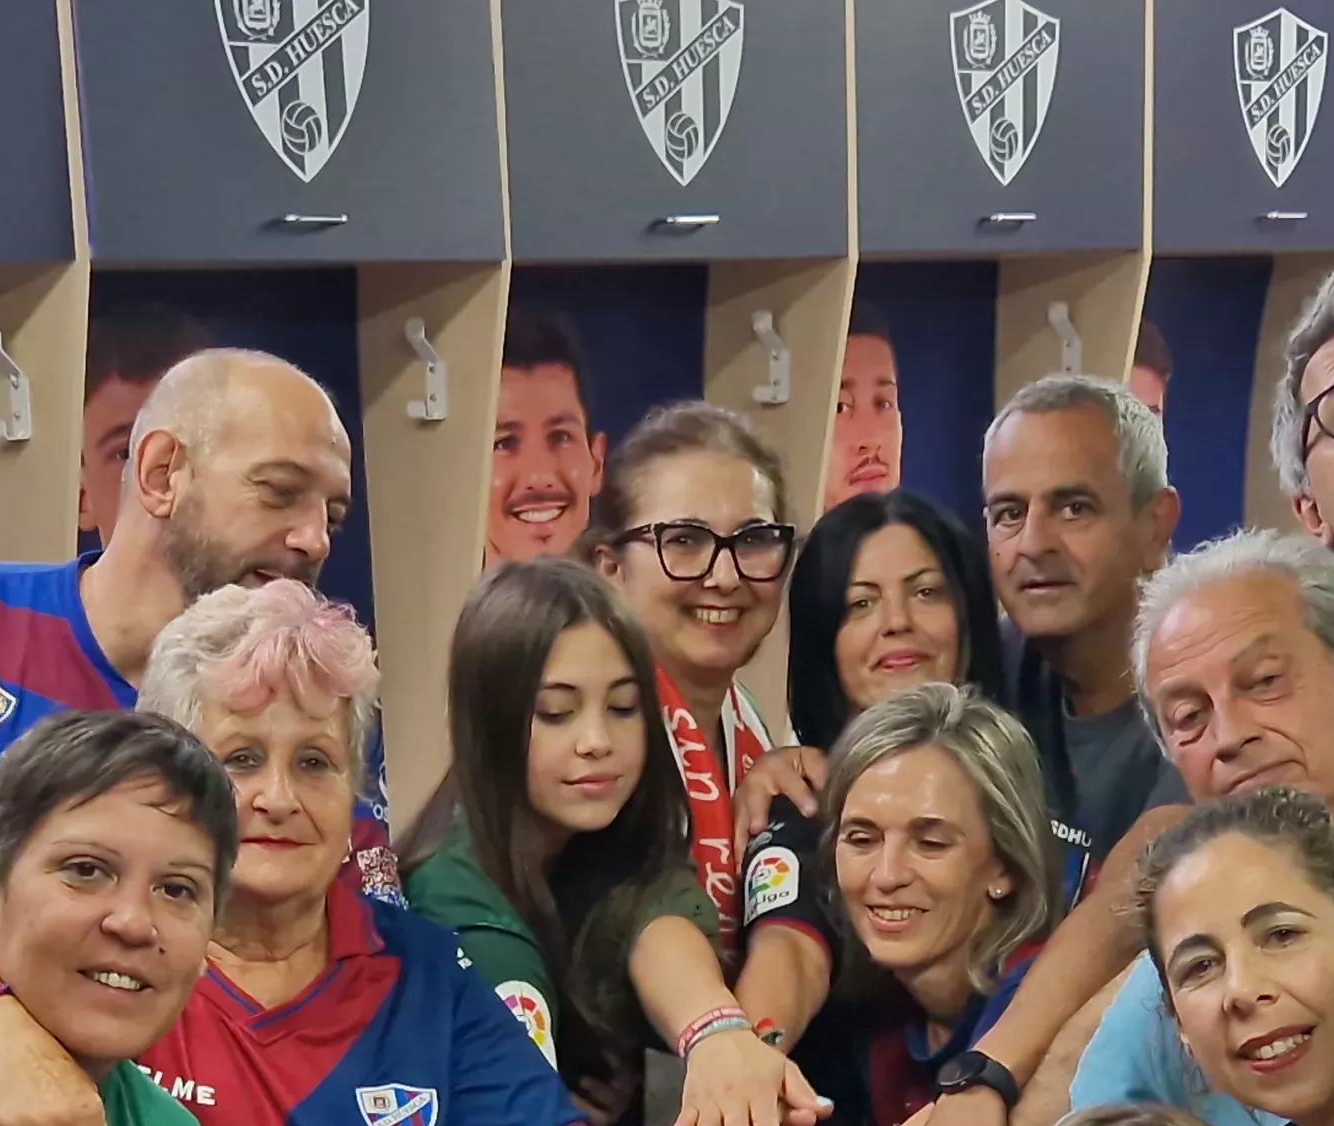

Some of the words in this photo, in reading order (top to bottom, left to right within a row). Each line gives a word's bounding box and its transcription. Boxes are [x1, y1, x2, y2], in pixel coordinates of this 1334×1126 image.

[251, 61, 289, 97] S.D.
[284, 0, 360, 66] HUESCA
[642, 76, 675, 109] S.D.
[672, 15, 736, 81] HUESCA
[971, 85, 1000, 115] S.D.
[996, 29, 1052, 91] HUESCA
[1250, 95, 1276, 122] S.D.
[1273, 43, 1321, 98] HUESCA
